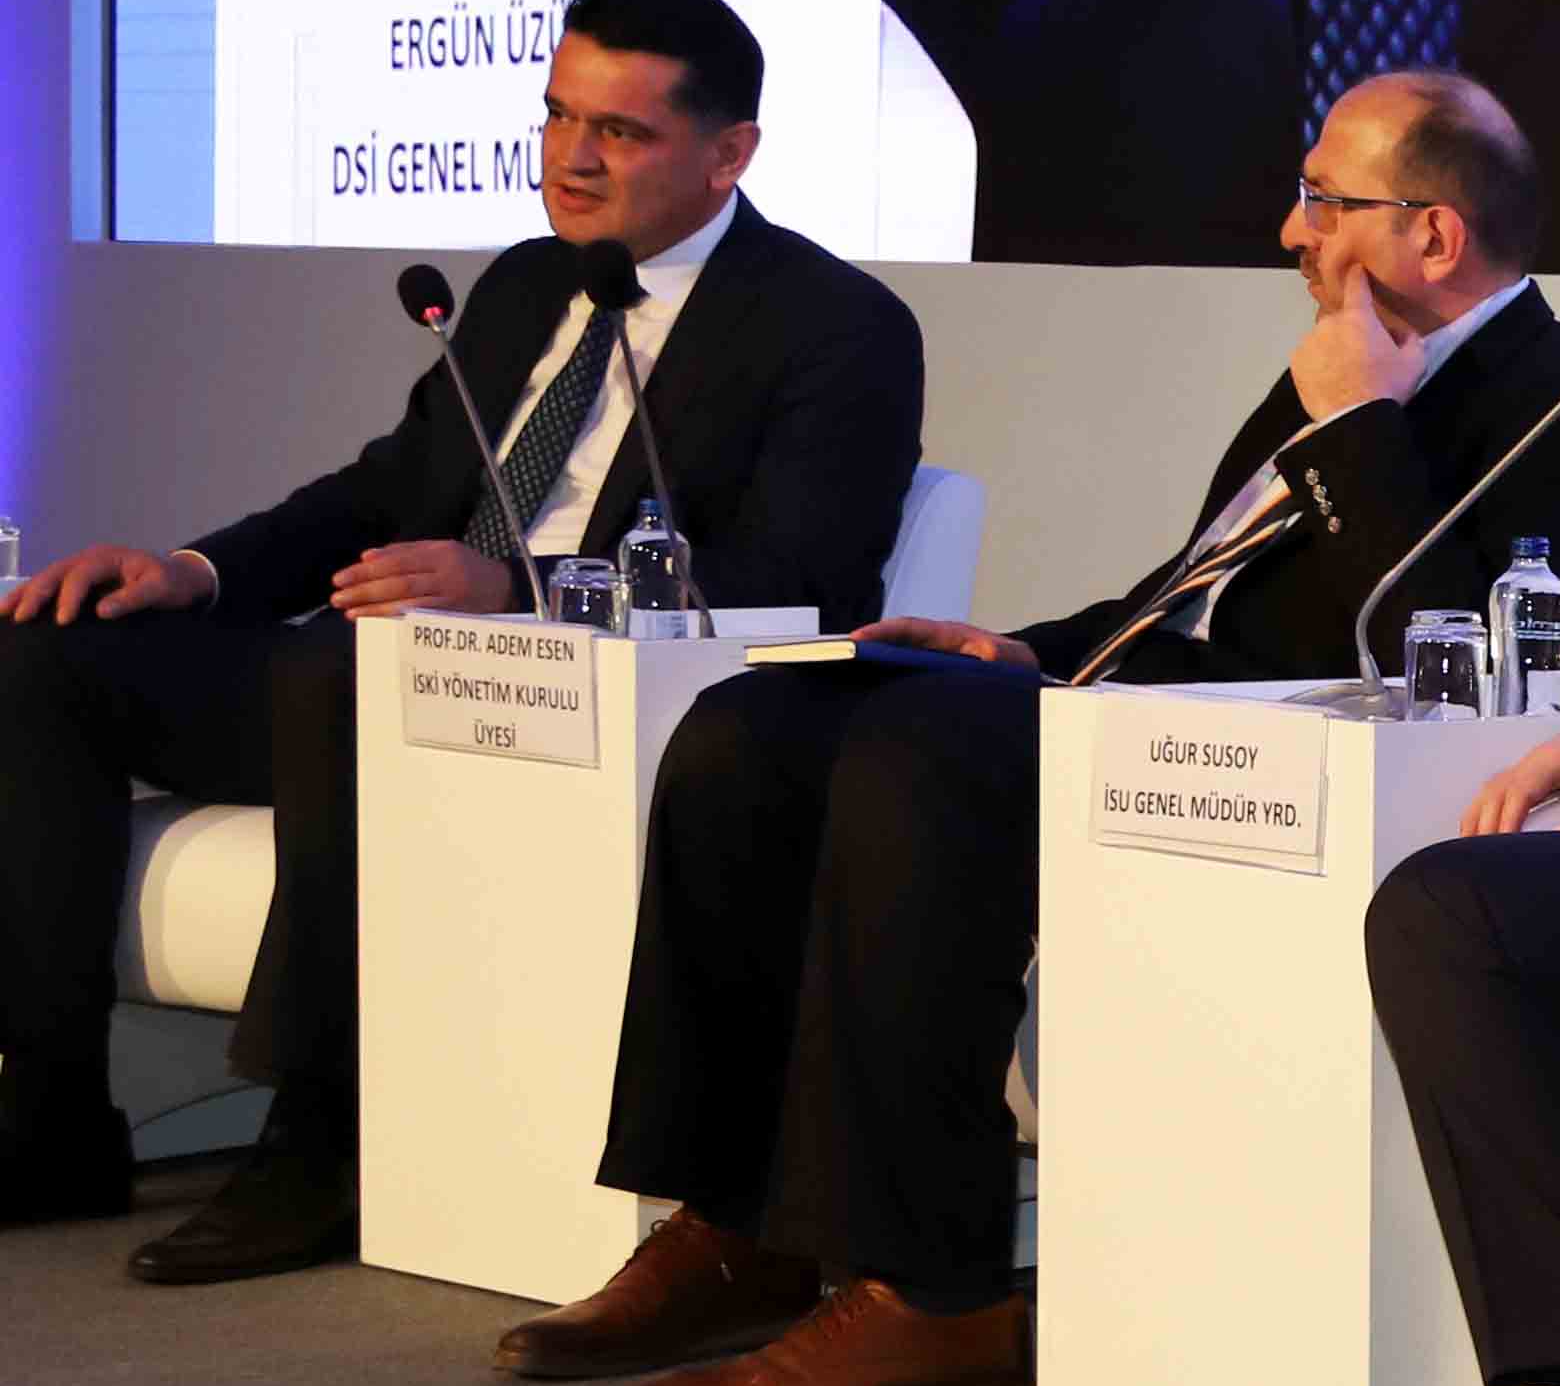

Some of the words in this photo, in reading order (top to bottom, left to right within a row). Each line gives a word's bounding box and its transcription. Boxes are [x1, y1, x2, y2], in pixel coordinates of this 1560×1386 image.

[391, 2, 495, 70] ERGÜN
[332, 131, 377, 196] DSİ
[388, 139, 482, 194] GENEL
[413, 625, 482, 654] PROF.DR.
[486, 632, 532, 659] ADEM
[535, 637, 576, 662] ESEN
[412, 668, 440, 696] İSKİ
[442, 672, 512, 705] YÖNETİM
[514, 686, 579, 712] KURULU
[473, 719, 517, 749] ÜYESİ
[1149, 734, 1198, 766] UĞUR
[1201, 743, 1259, 771] SUSOY
[1104, 783, 1131, 813] İSU
[1134, 790, 1186, 819] GENEL
[1189, 791, 1257, 824] MÜDÜR
[1261, 801, 1302, 829] YRD.
